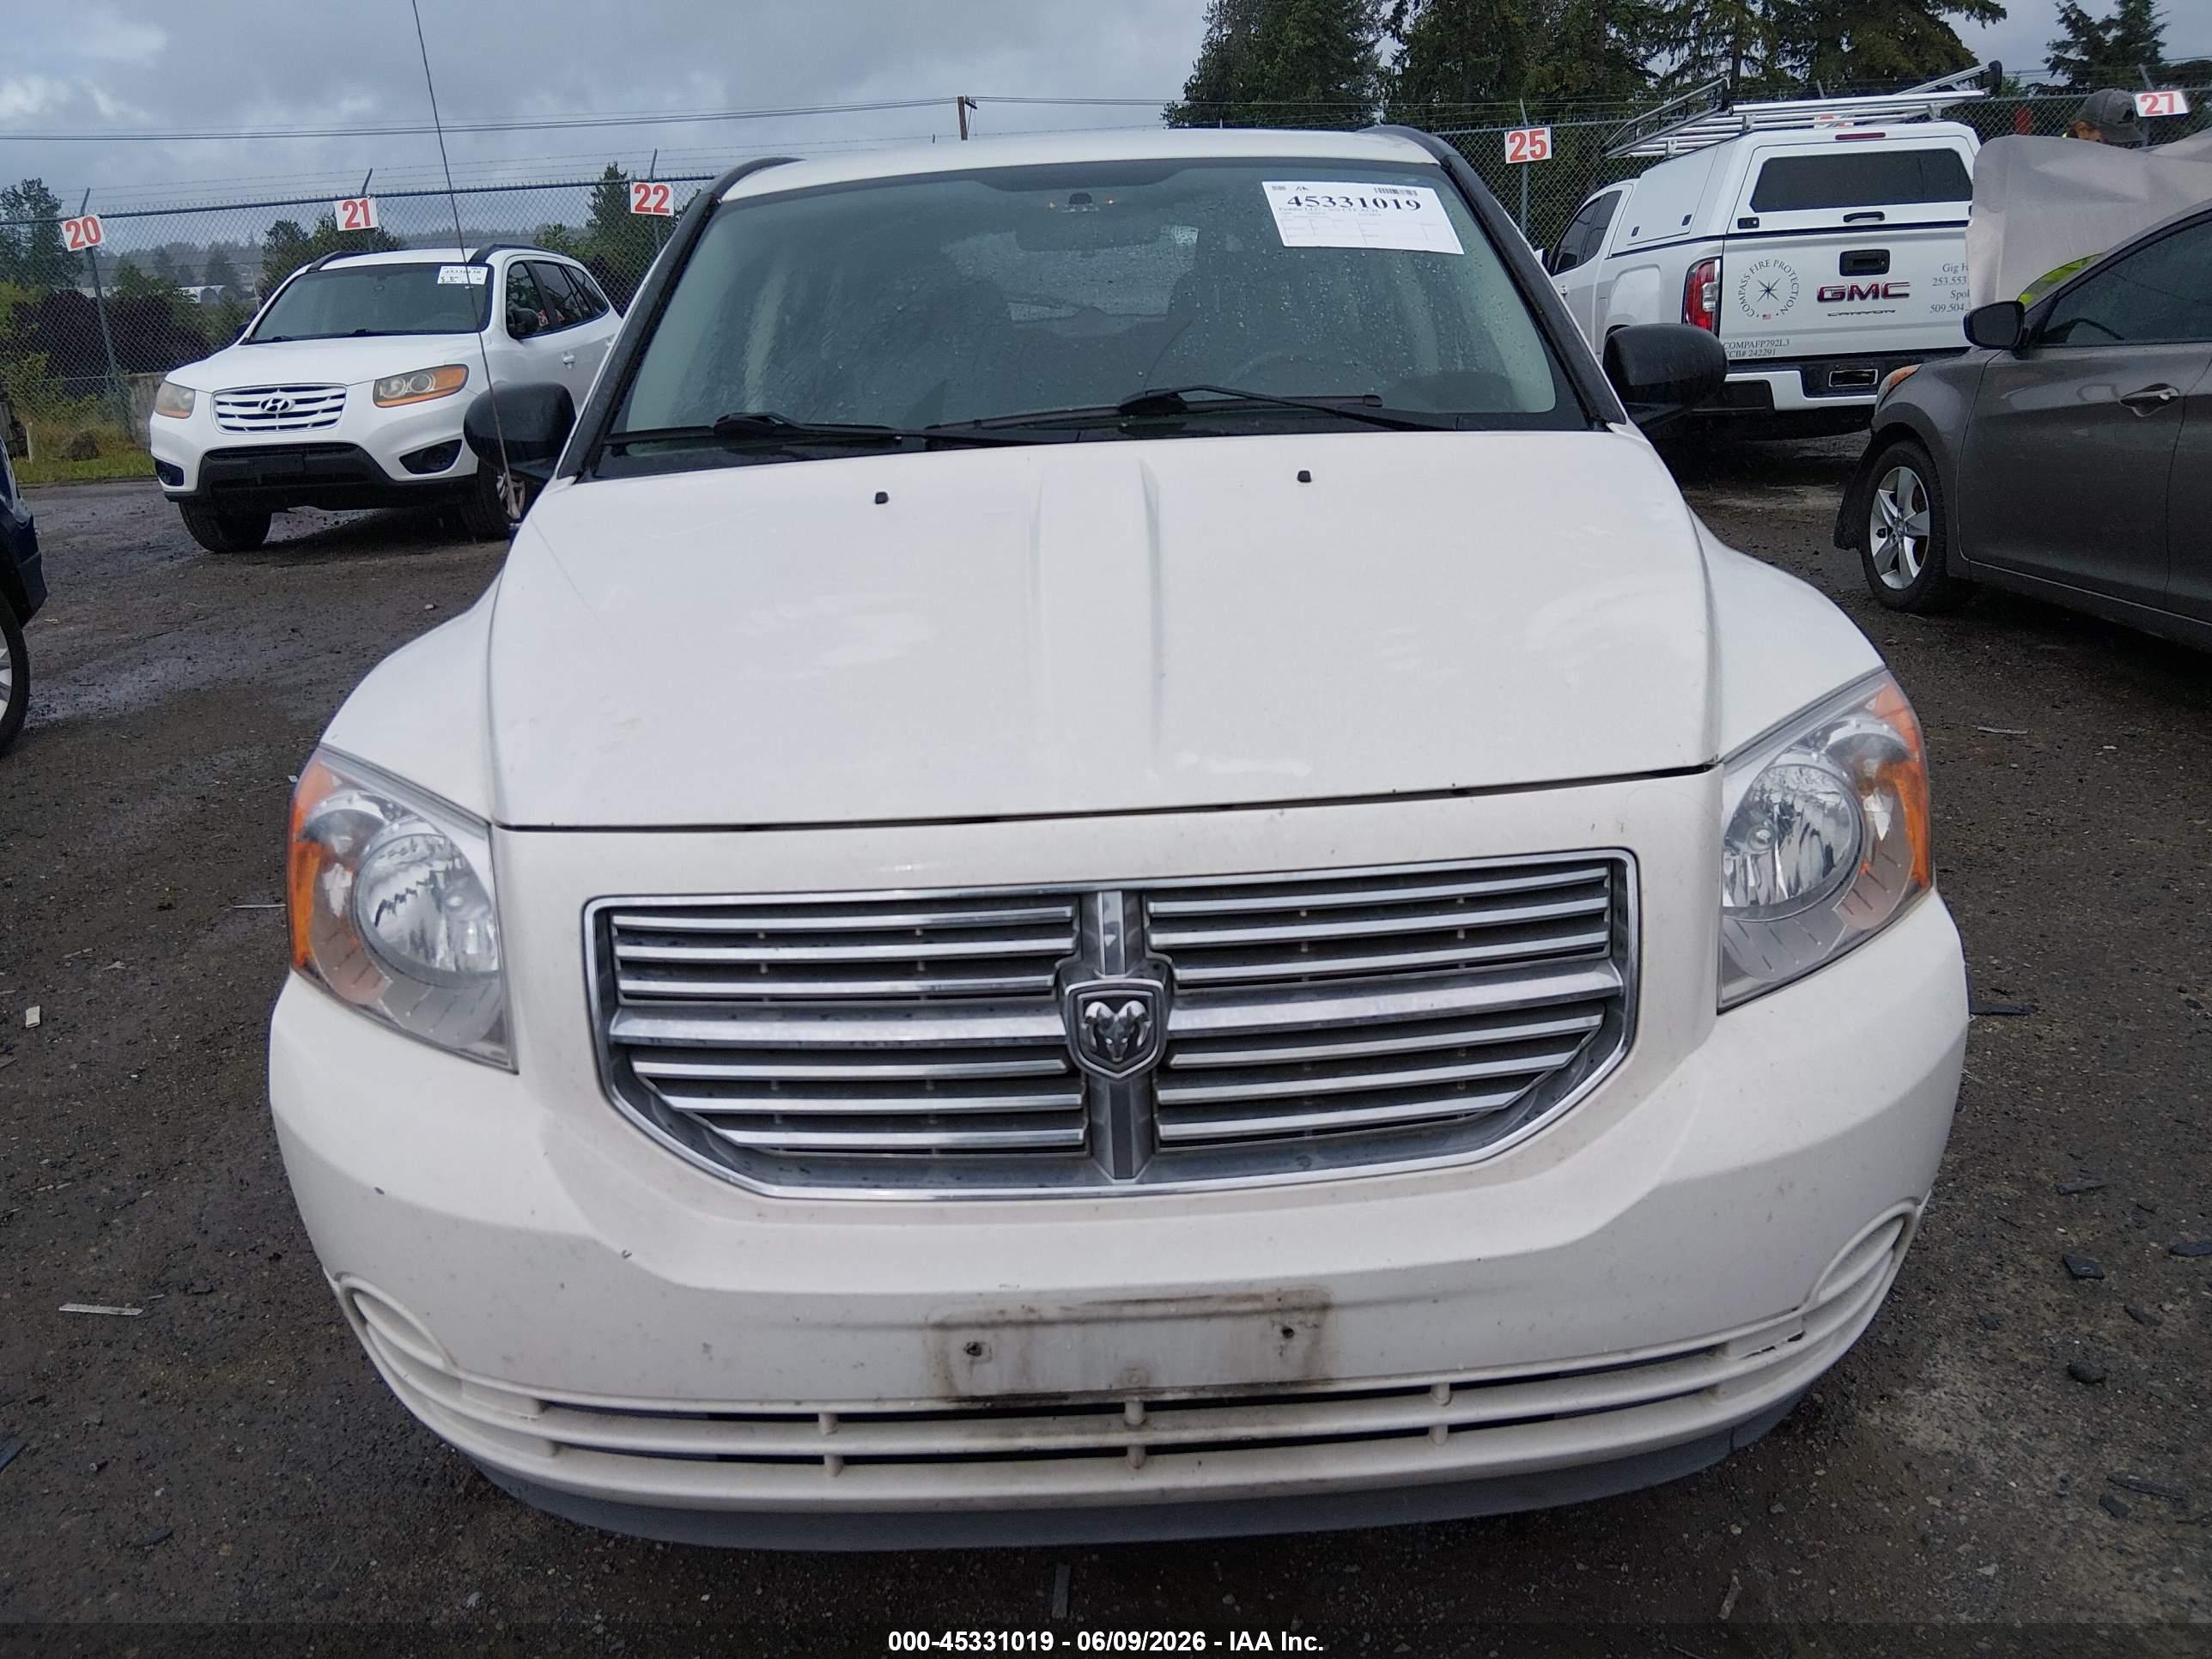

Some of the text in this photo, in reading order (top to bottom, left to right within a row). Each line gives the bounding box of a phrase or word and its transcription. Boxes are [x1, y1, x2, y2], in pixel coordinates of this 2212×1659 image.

[2140, 93, 2175, 115] 27
[1509, 130, 1547, 161] 25
[635, 184, 670, 213] 22
[1287, 195, 1422, 211] 45331019
[343, 199, 371, 228] 21
[65, 216, 101, 248] 20
[1942, 263, 1959, 274] Gig
[1738, 259, 1800, 317] COMPASS FIRE PROTECTION
[1817, 282, 1911, 302] GMC
